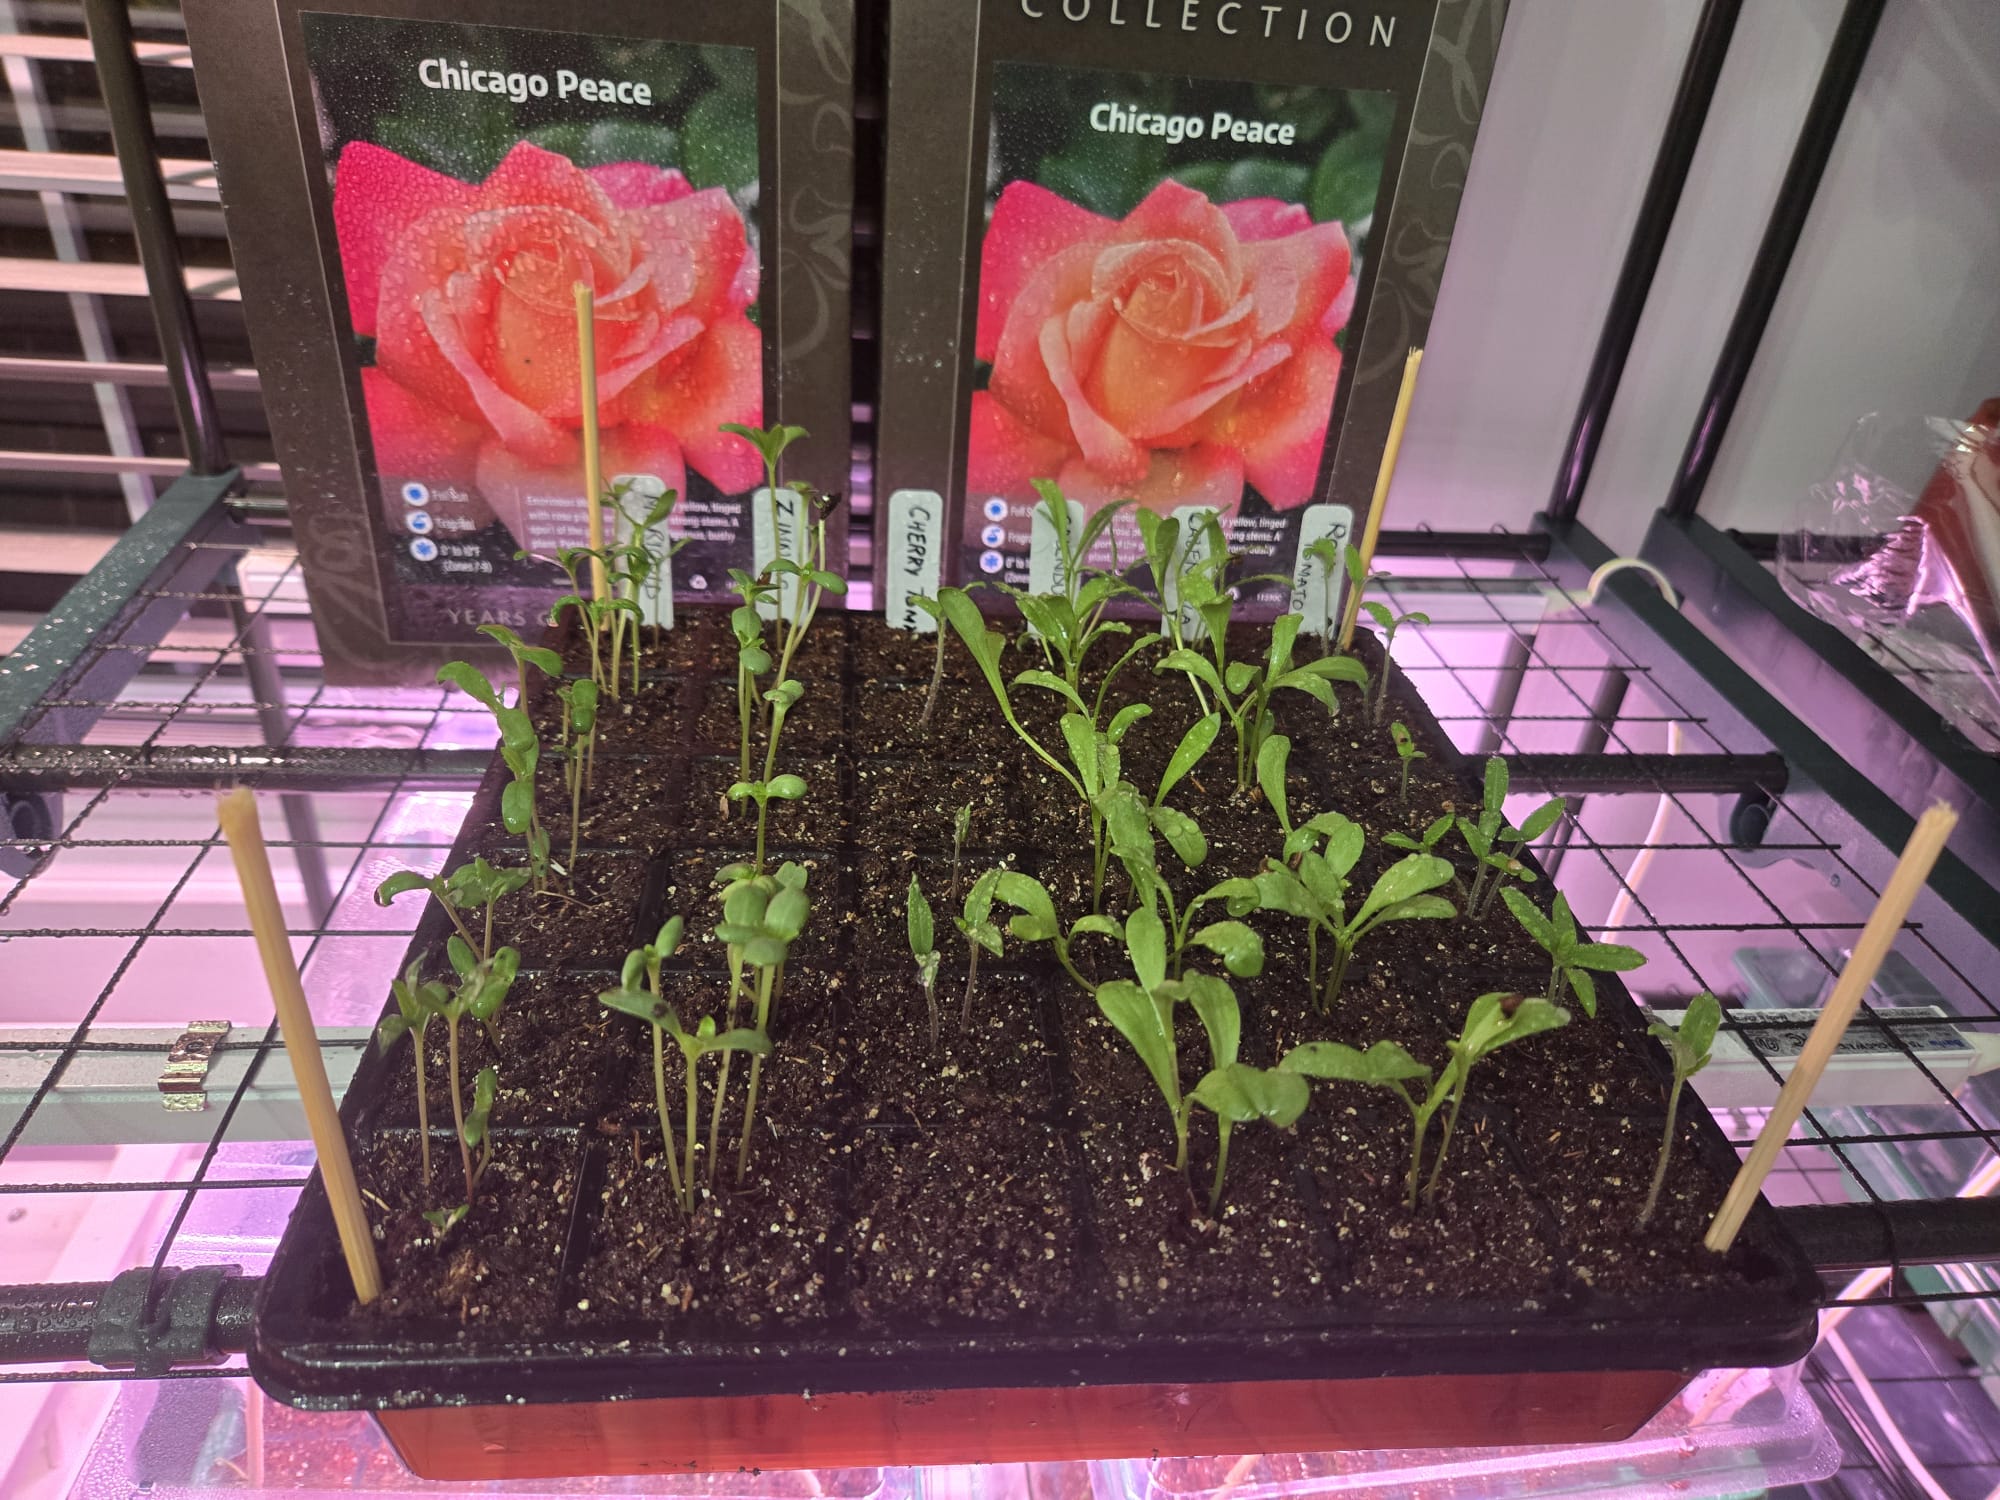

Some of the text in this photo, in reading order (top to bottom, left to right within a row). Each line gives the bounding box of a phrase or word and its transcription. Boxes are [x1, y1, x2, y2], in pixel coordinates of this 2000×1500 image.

[1020, 0, 1396, 47] COLLECTION
[418, 57, 653, 106] Chicago Peace
[1089, 102, 1296, 146] Chicago Peace
[903, 506, 931, 577] CHERRY
[1259, 516, 1287, 531] tinged
[448, 608, 527, 627] YEARS
